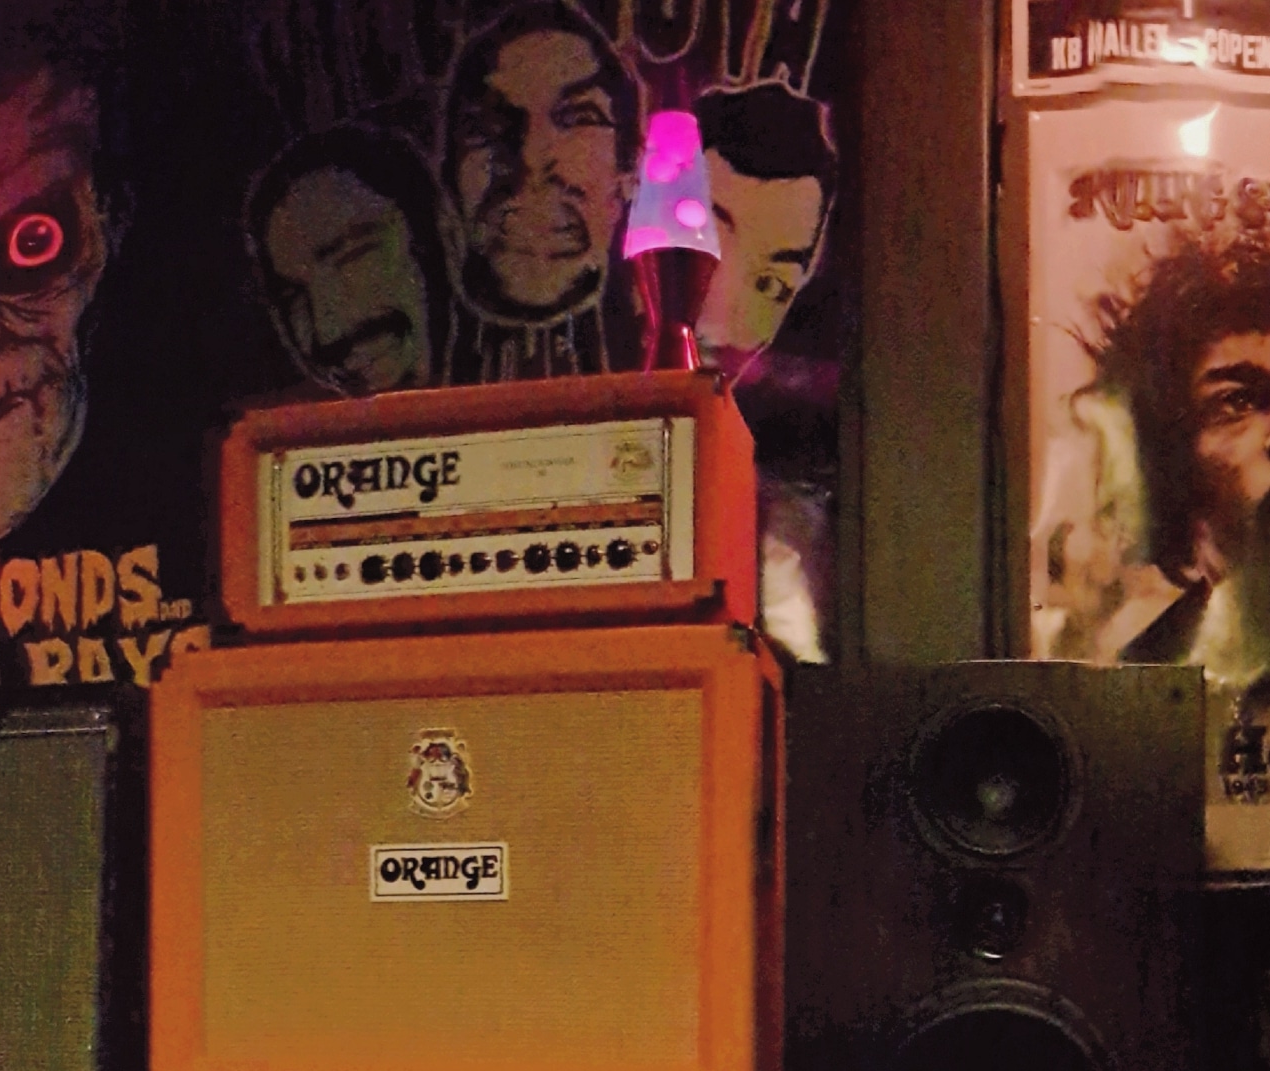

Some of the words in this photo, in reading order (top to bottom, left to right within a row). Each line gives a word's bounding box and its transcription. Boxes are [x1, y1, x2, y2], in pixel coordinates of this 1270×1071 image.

[1051, 37, 1083, 70] KB
[293, 450, 461, 508] ORANGE
[380, 855, 499, 891] ORANGE
